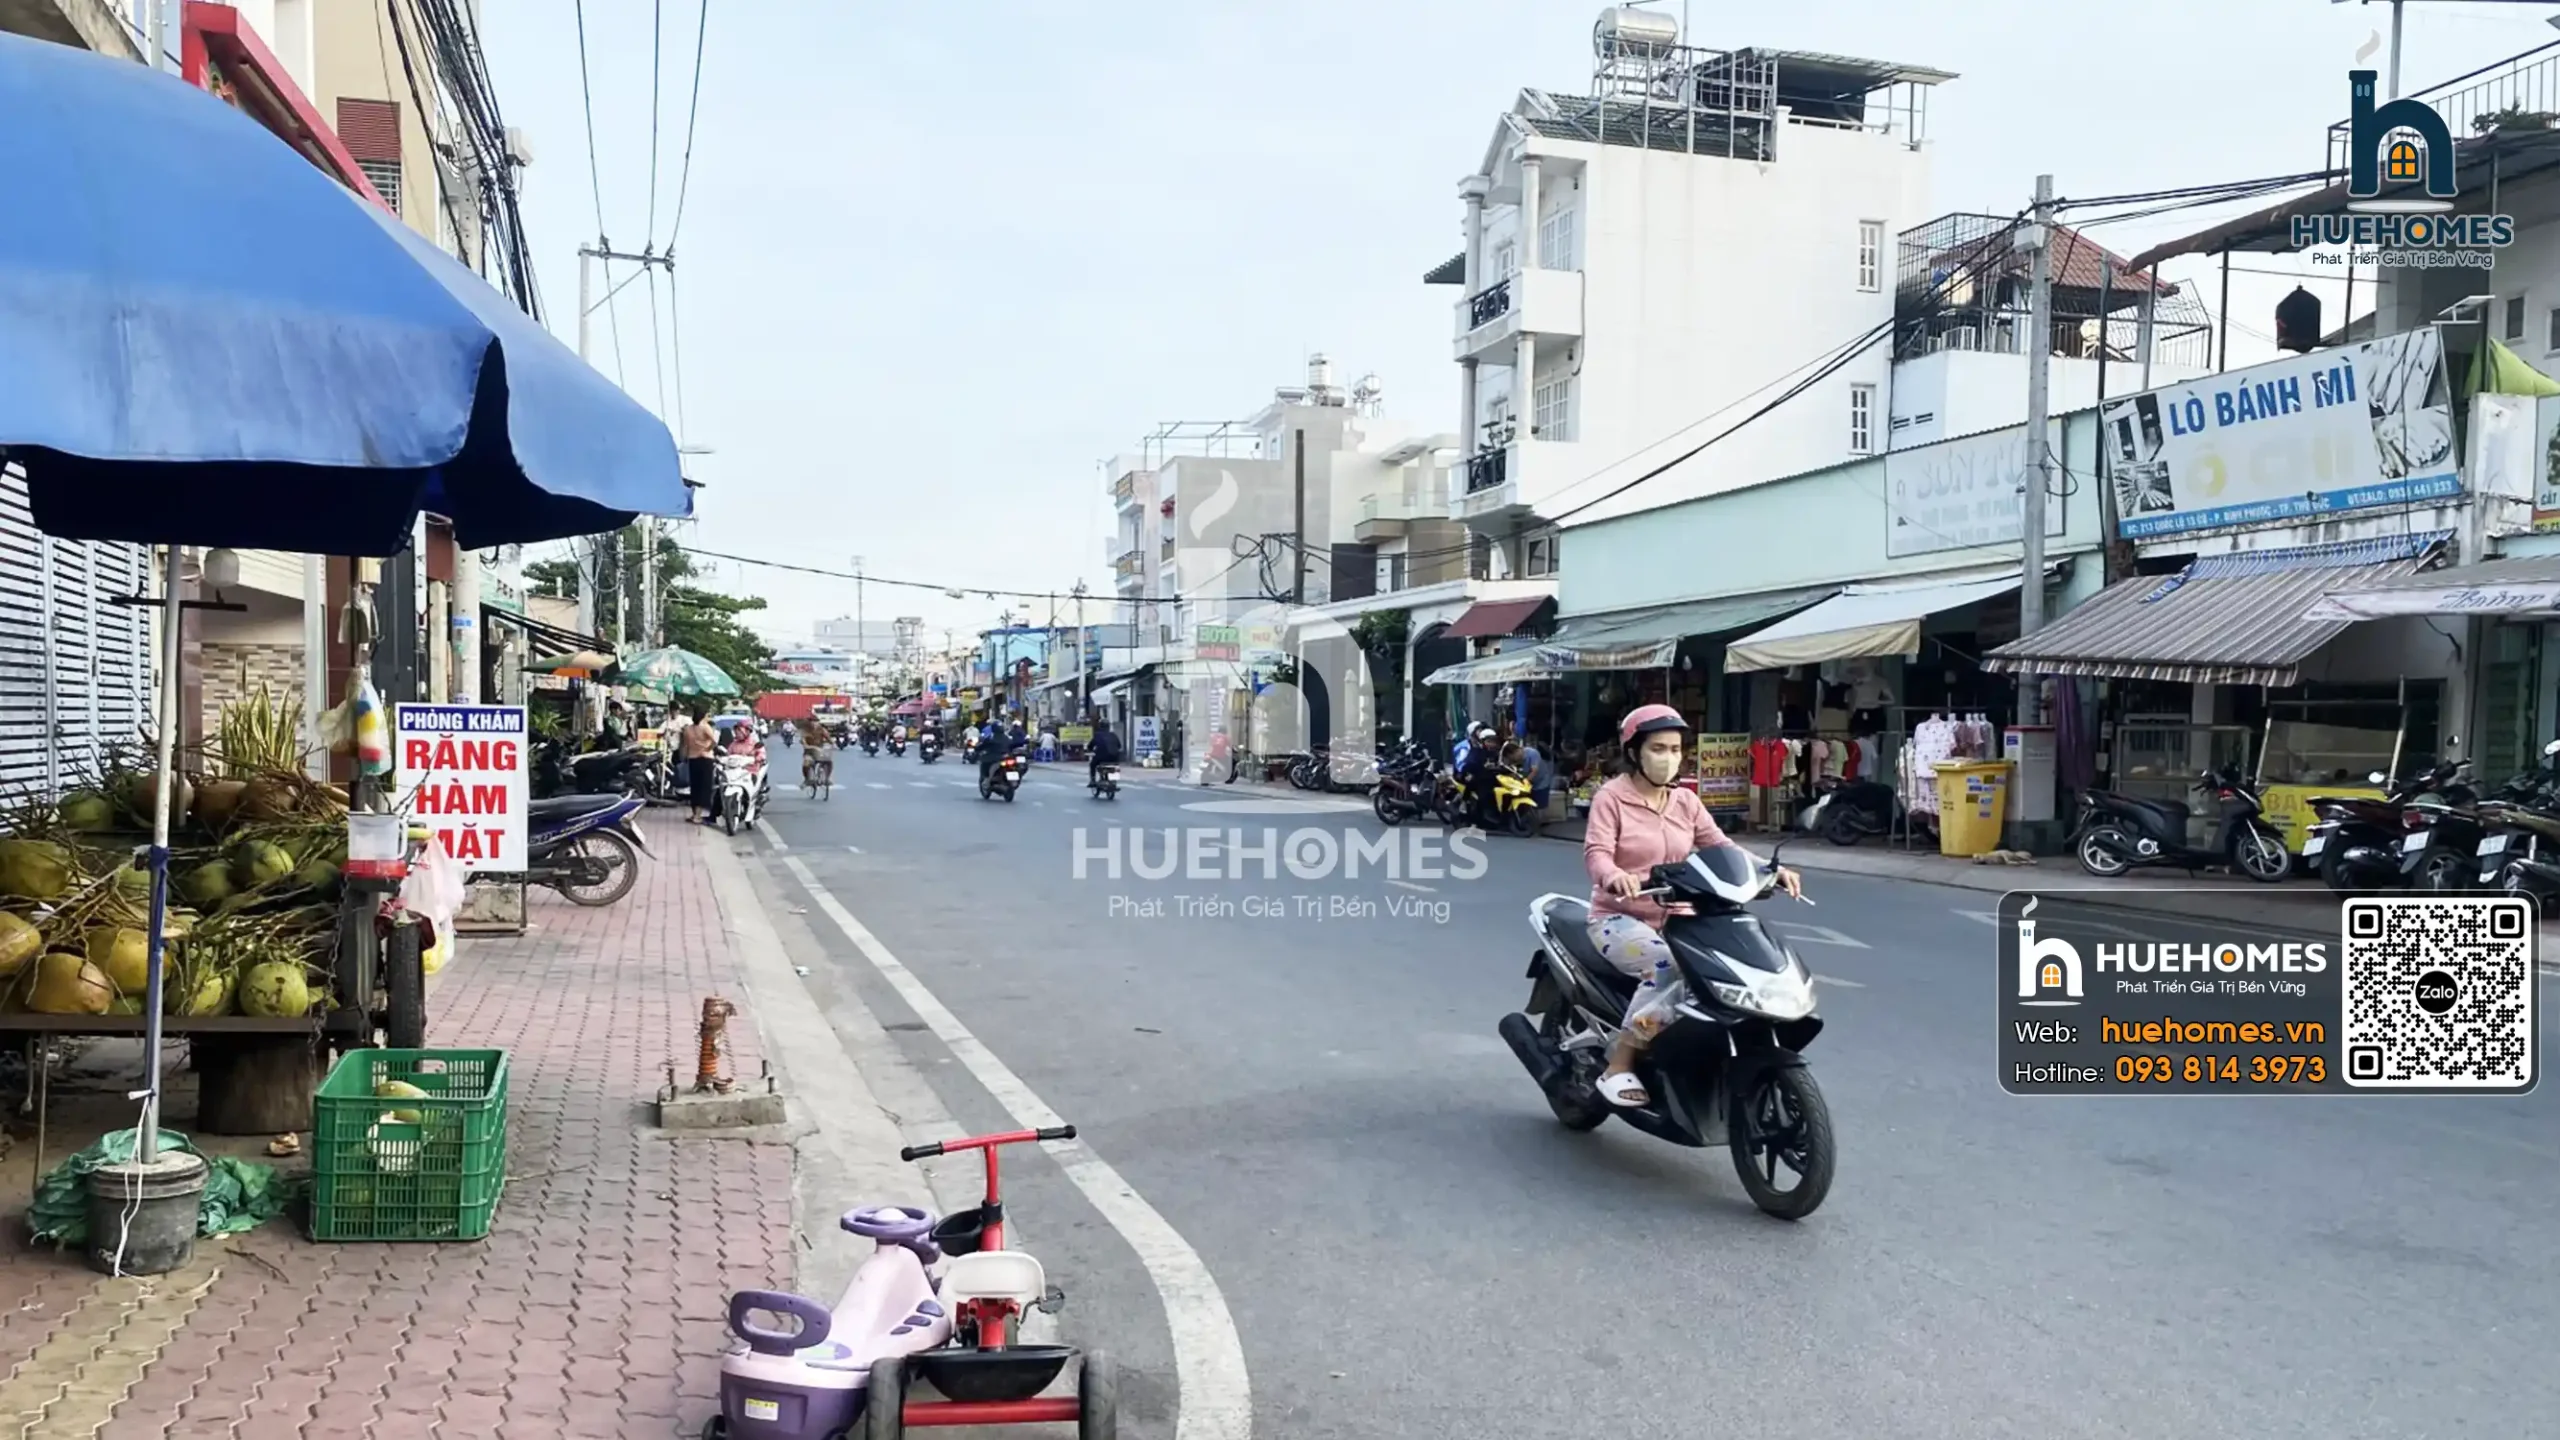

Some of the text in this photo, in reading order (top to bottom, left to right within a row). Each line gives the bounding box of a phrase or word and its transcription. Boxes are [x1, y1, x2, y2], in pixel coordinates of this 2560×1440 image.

[2169, 356, 2357, 436] LÒ BÁNH MÌ
[402, 708, 520, 731] PHÒNG KHÁM
[406, 733, 518, 771] RĂNG
[416, 778, 507, 814] HÀM
